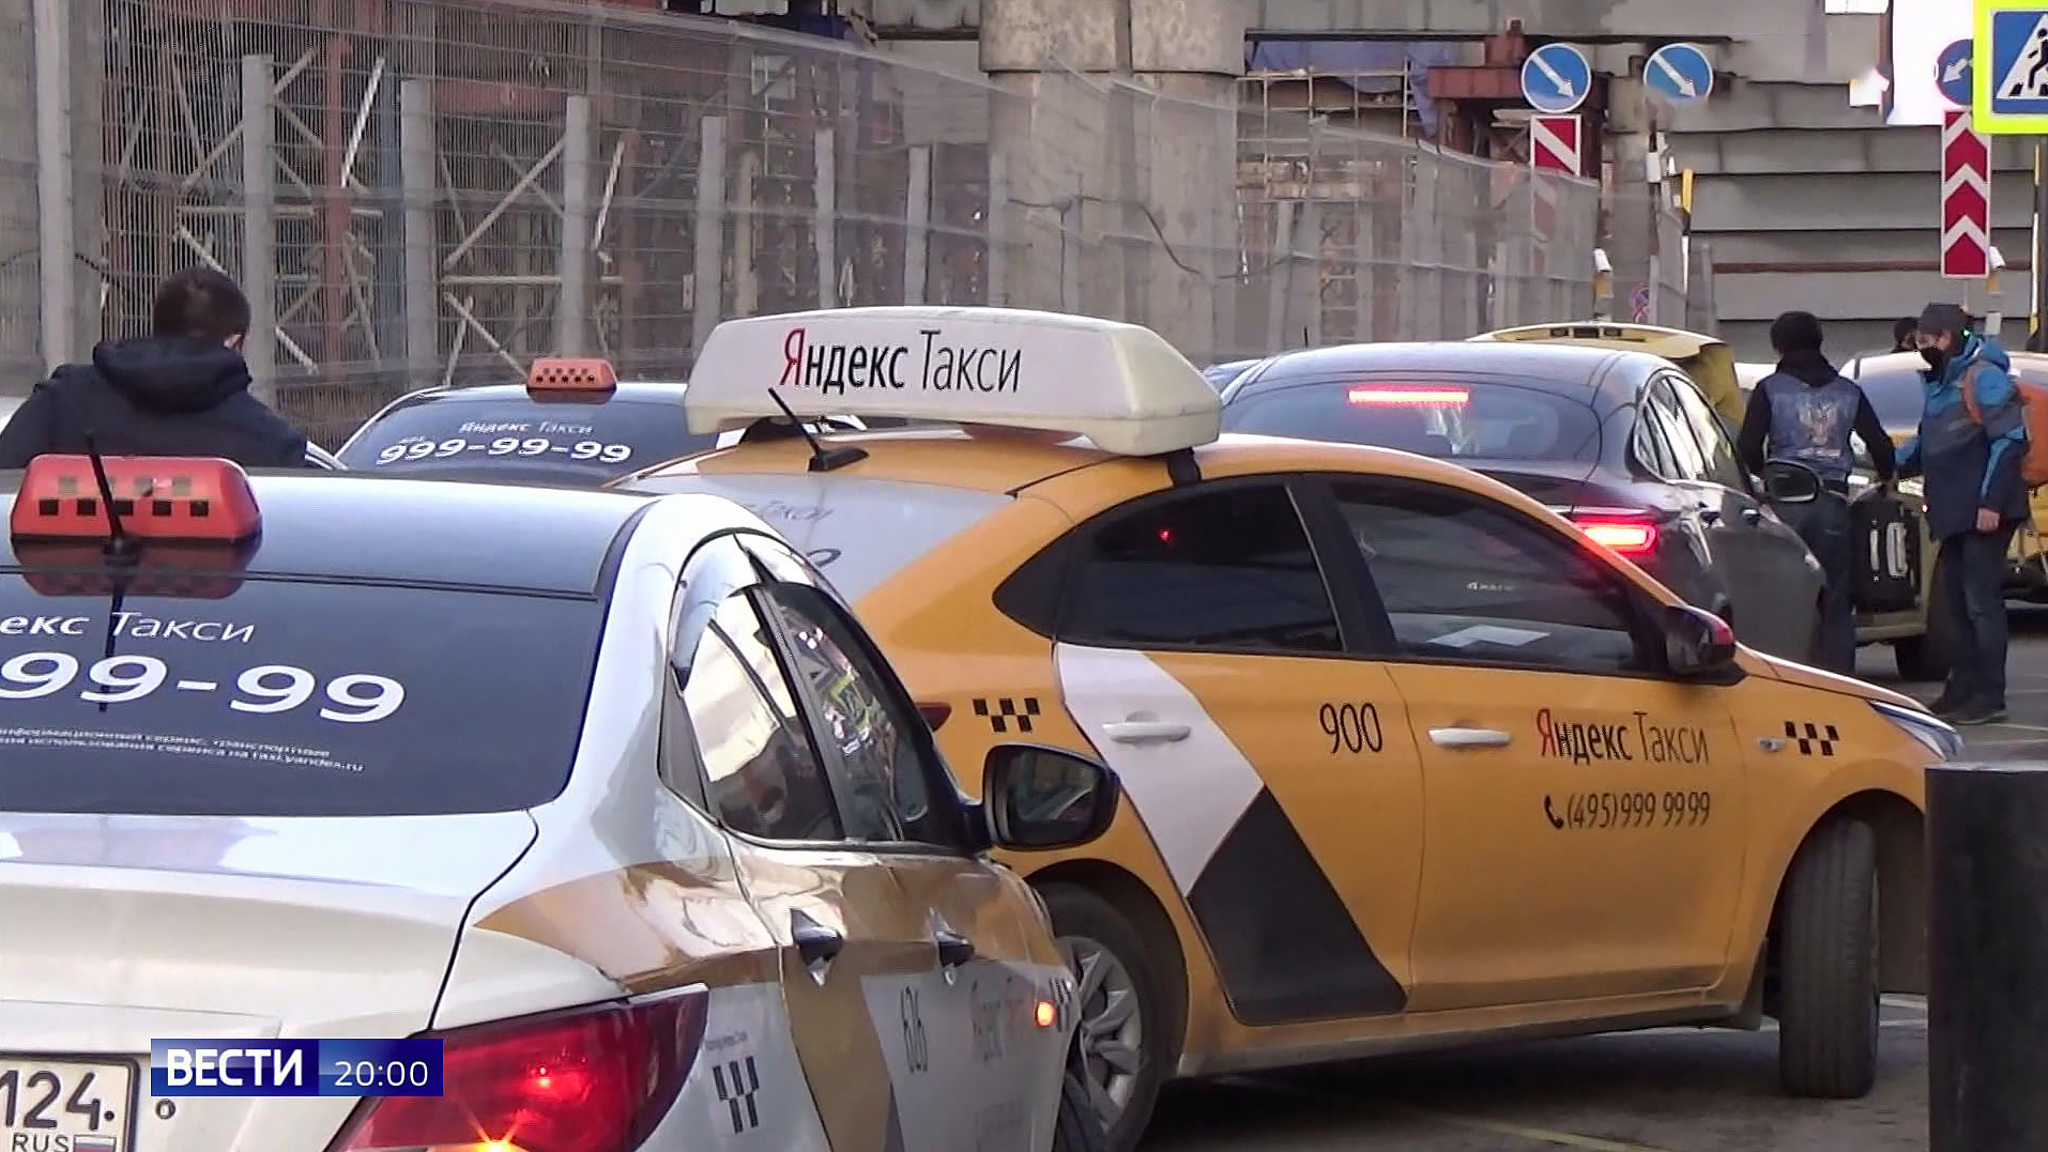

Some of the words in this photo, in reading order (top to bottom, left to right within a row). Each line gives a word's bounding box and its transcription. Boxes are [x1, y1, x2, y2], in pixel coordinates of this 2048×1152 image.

[779, 327, 908, 395] Яндекс
[920, 329, 1021, 393] Такси
[375, 436, 632, 465] 999-99-99
[110, 611, 255, 643] Такси
[1319, 702, 1384, 754] 900
[1536, 708, 1634, 765] Яндекс
[1633, 711, 1710, 764] Такси
[1662, 791, 1711, 828] 9999
[12, 1132, 69, 1152] RUS
